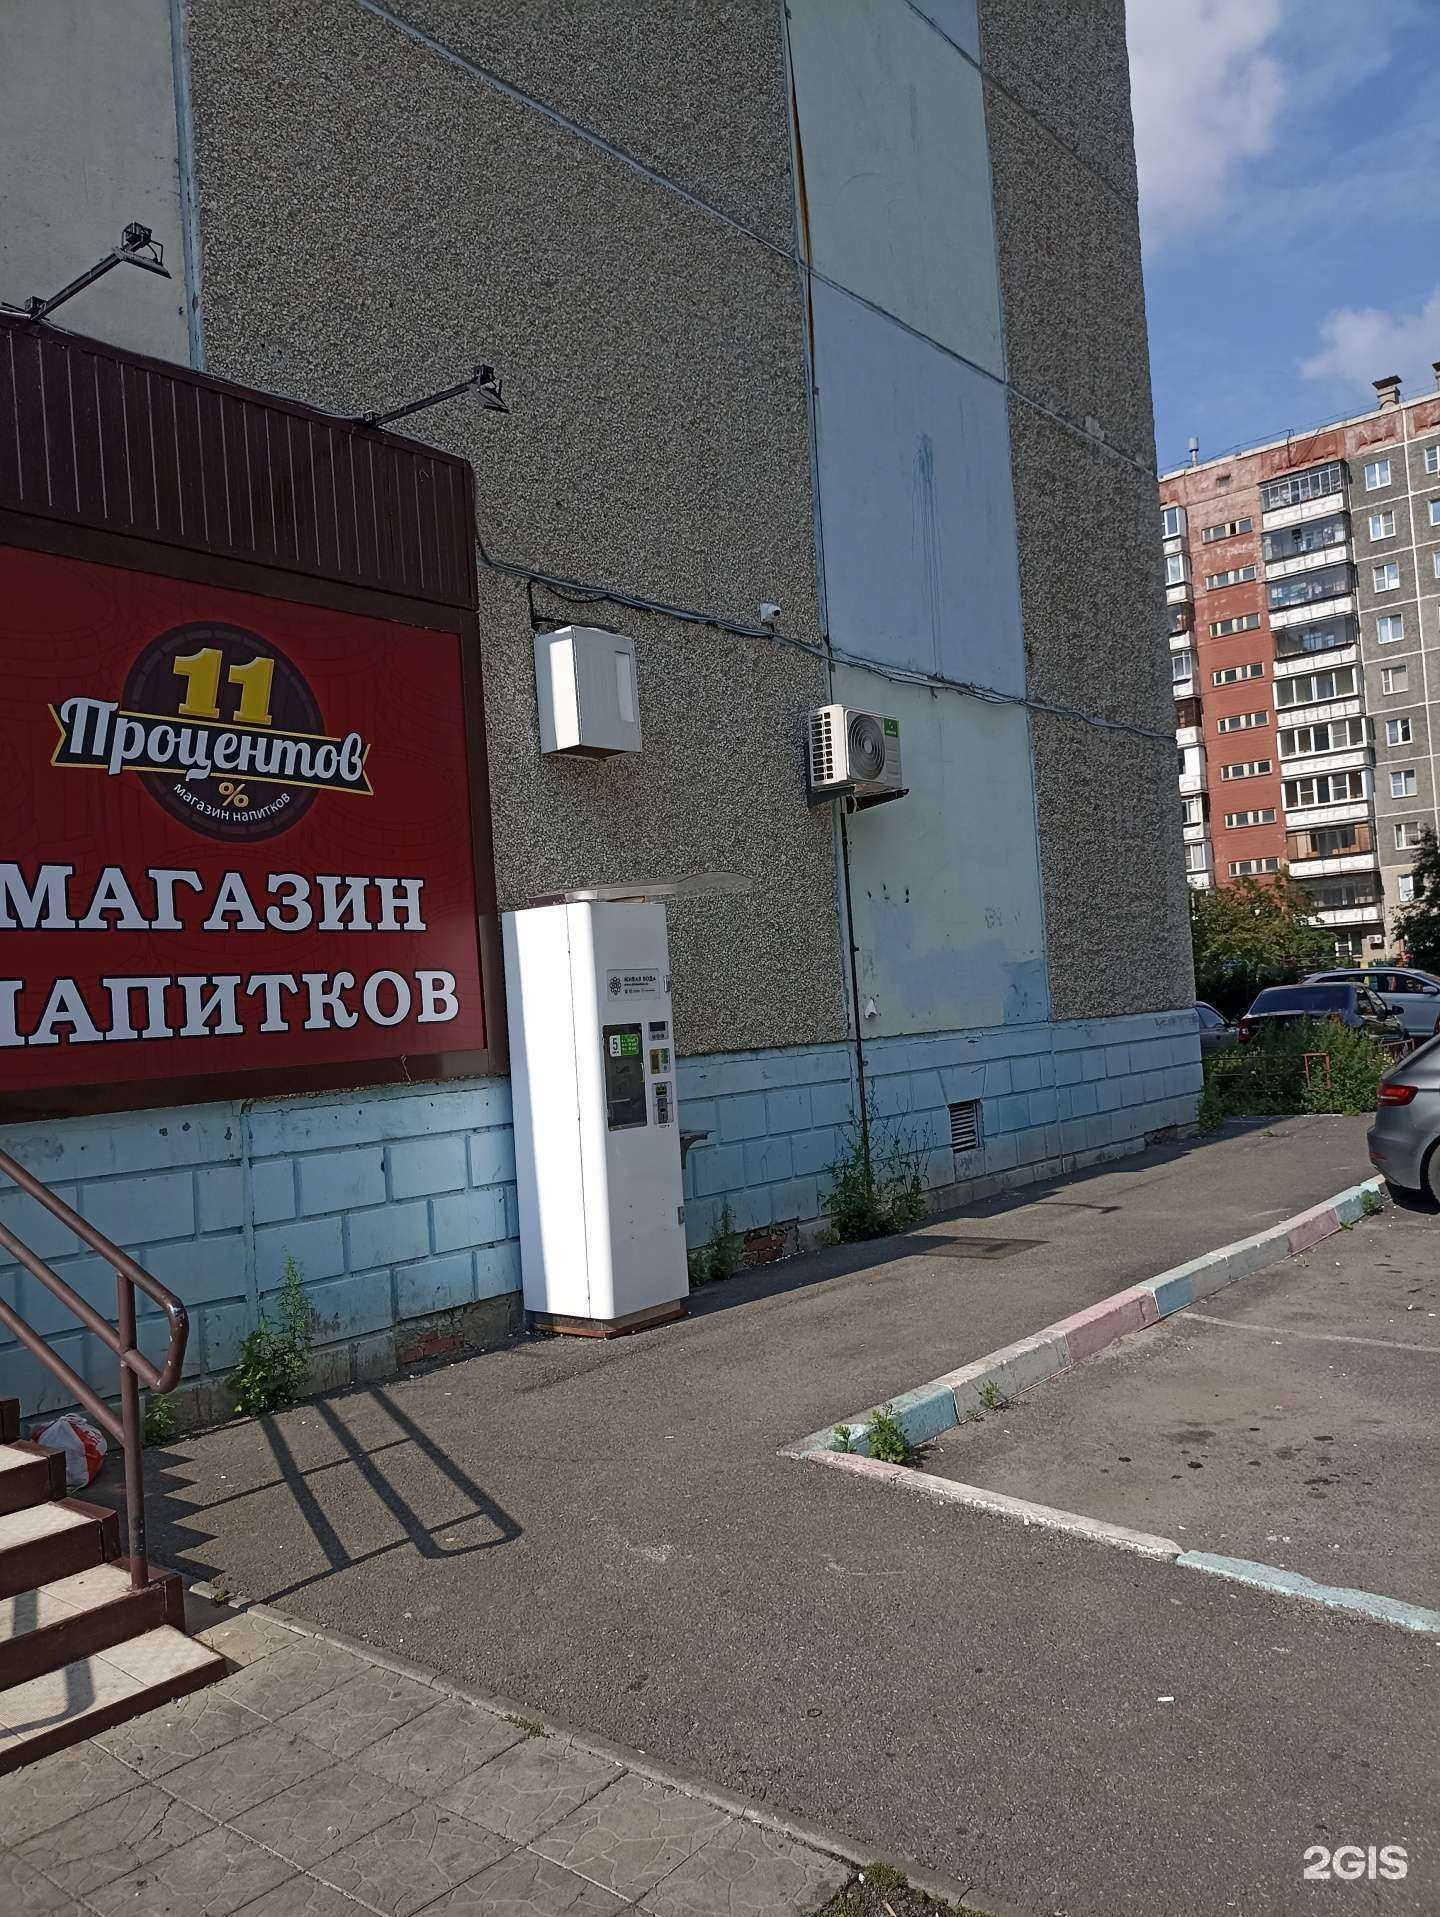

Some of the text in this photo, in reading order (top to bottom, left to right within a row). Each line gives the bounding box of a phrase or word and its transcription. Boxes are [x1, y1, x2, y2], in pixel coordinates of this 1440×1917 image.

[172, 647, 275, 726] 11
[60, 696, 364, 782] Процентов
[173, 783, 291, 822] магазин напитков
[218, 781, 249, 808] %
[0, 863, 427, 931] МАГАЗИН
[612, 1037, 618, 1051] 5
